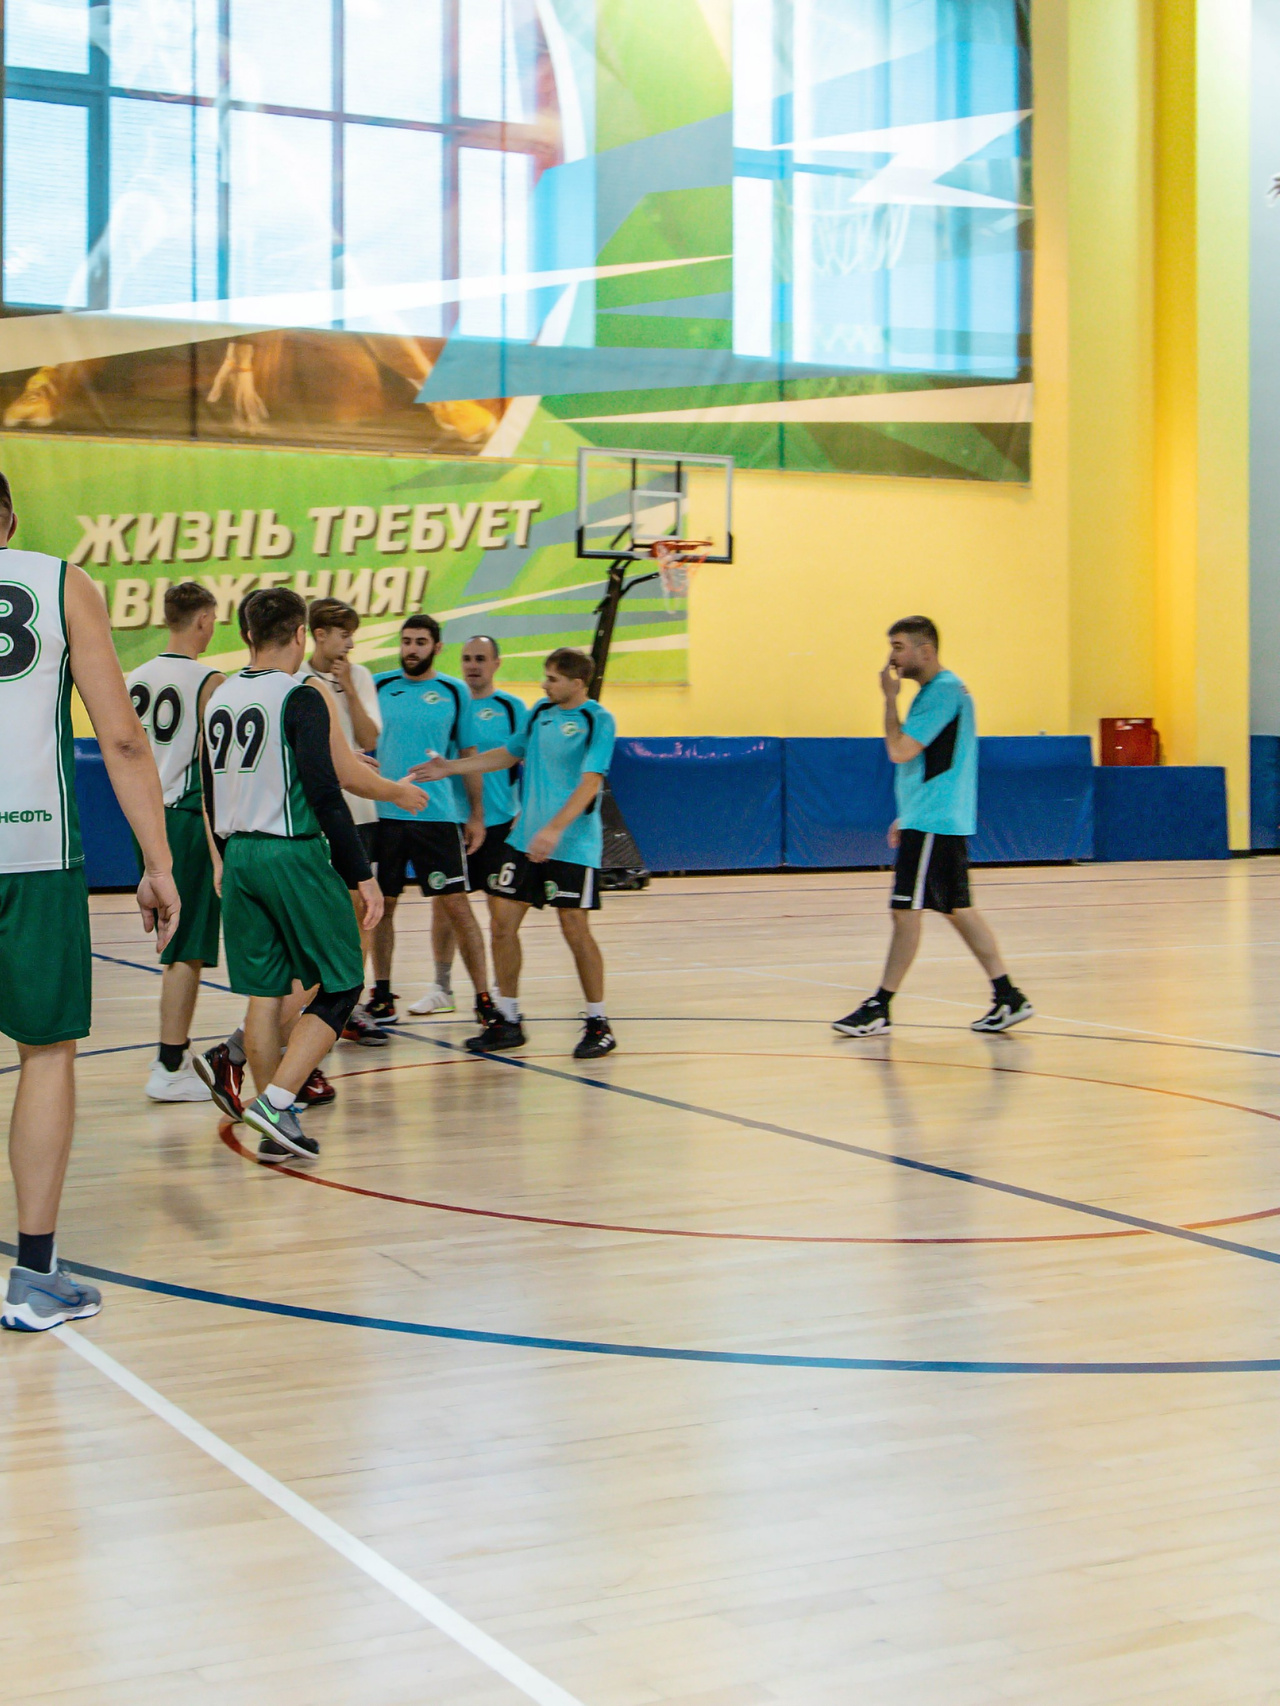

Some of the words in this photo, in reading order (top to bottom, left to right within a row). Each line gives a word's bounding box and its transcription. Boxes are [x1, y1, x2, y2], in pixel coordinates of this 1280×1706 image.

[70, 509, 294, 566] ЖИЗНЬ
[309, 500, 542, 557] ТРЕБУЕТ
[208, 703, 269, 774] 99
[498, 862, 516, 886] 6
